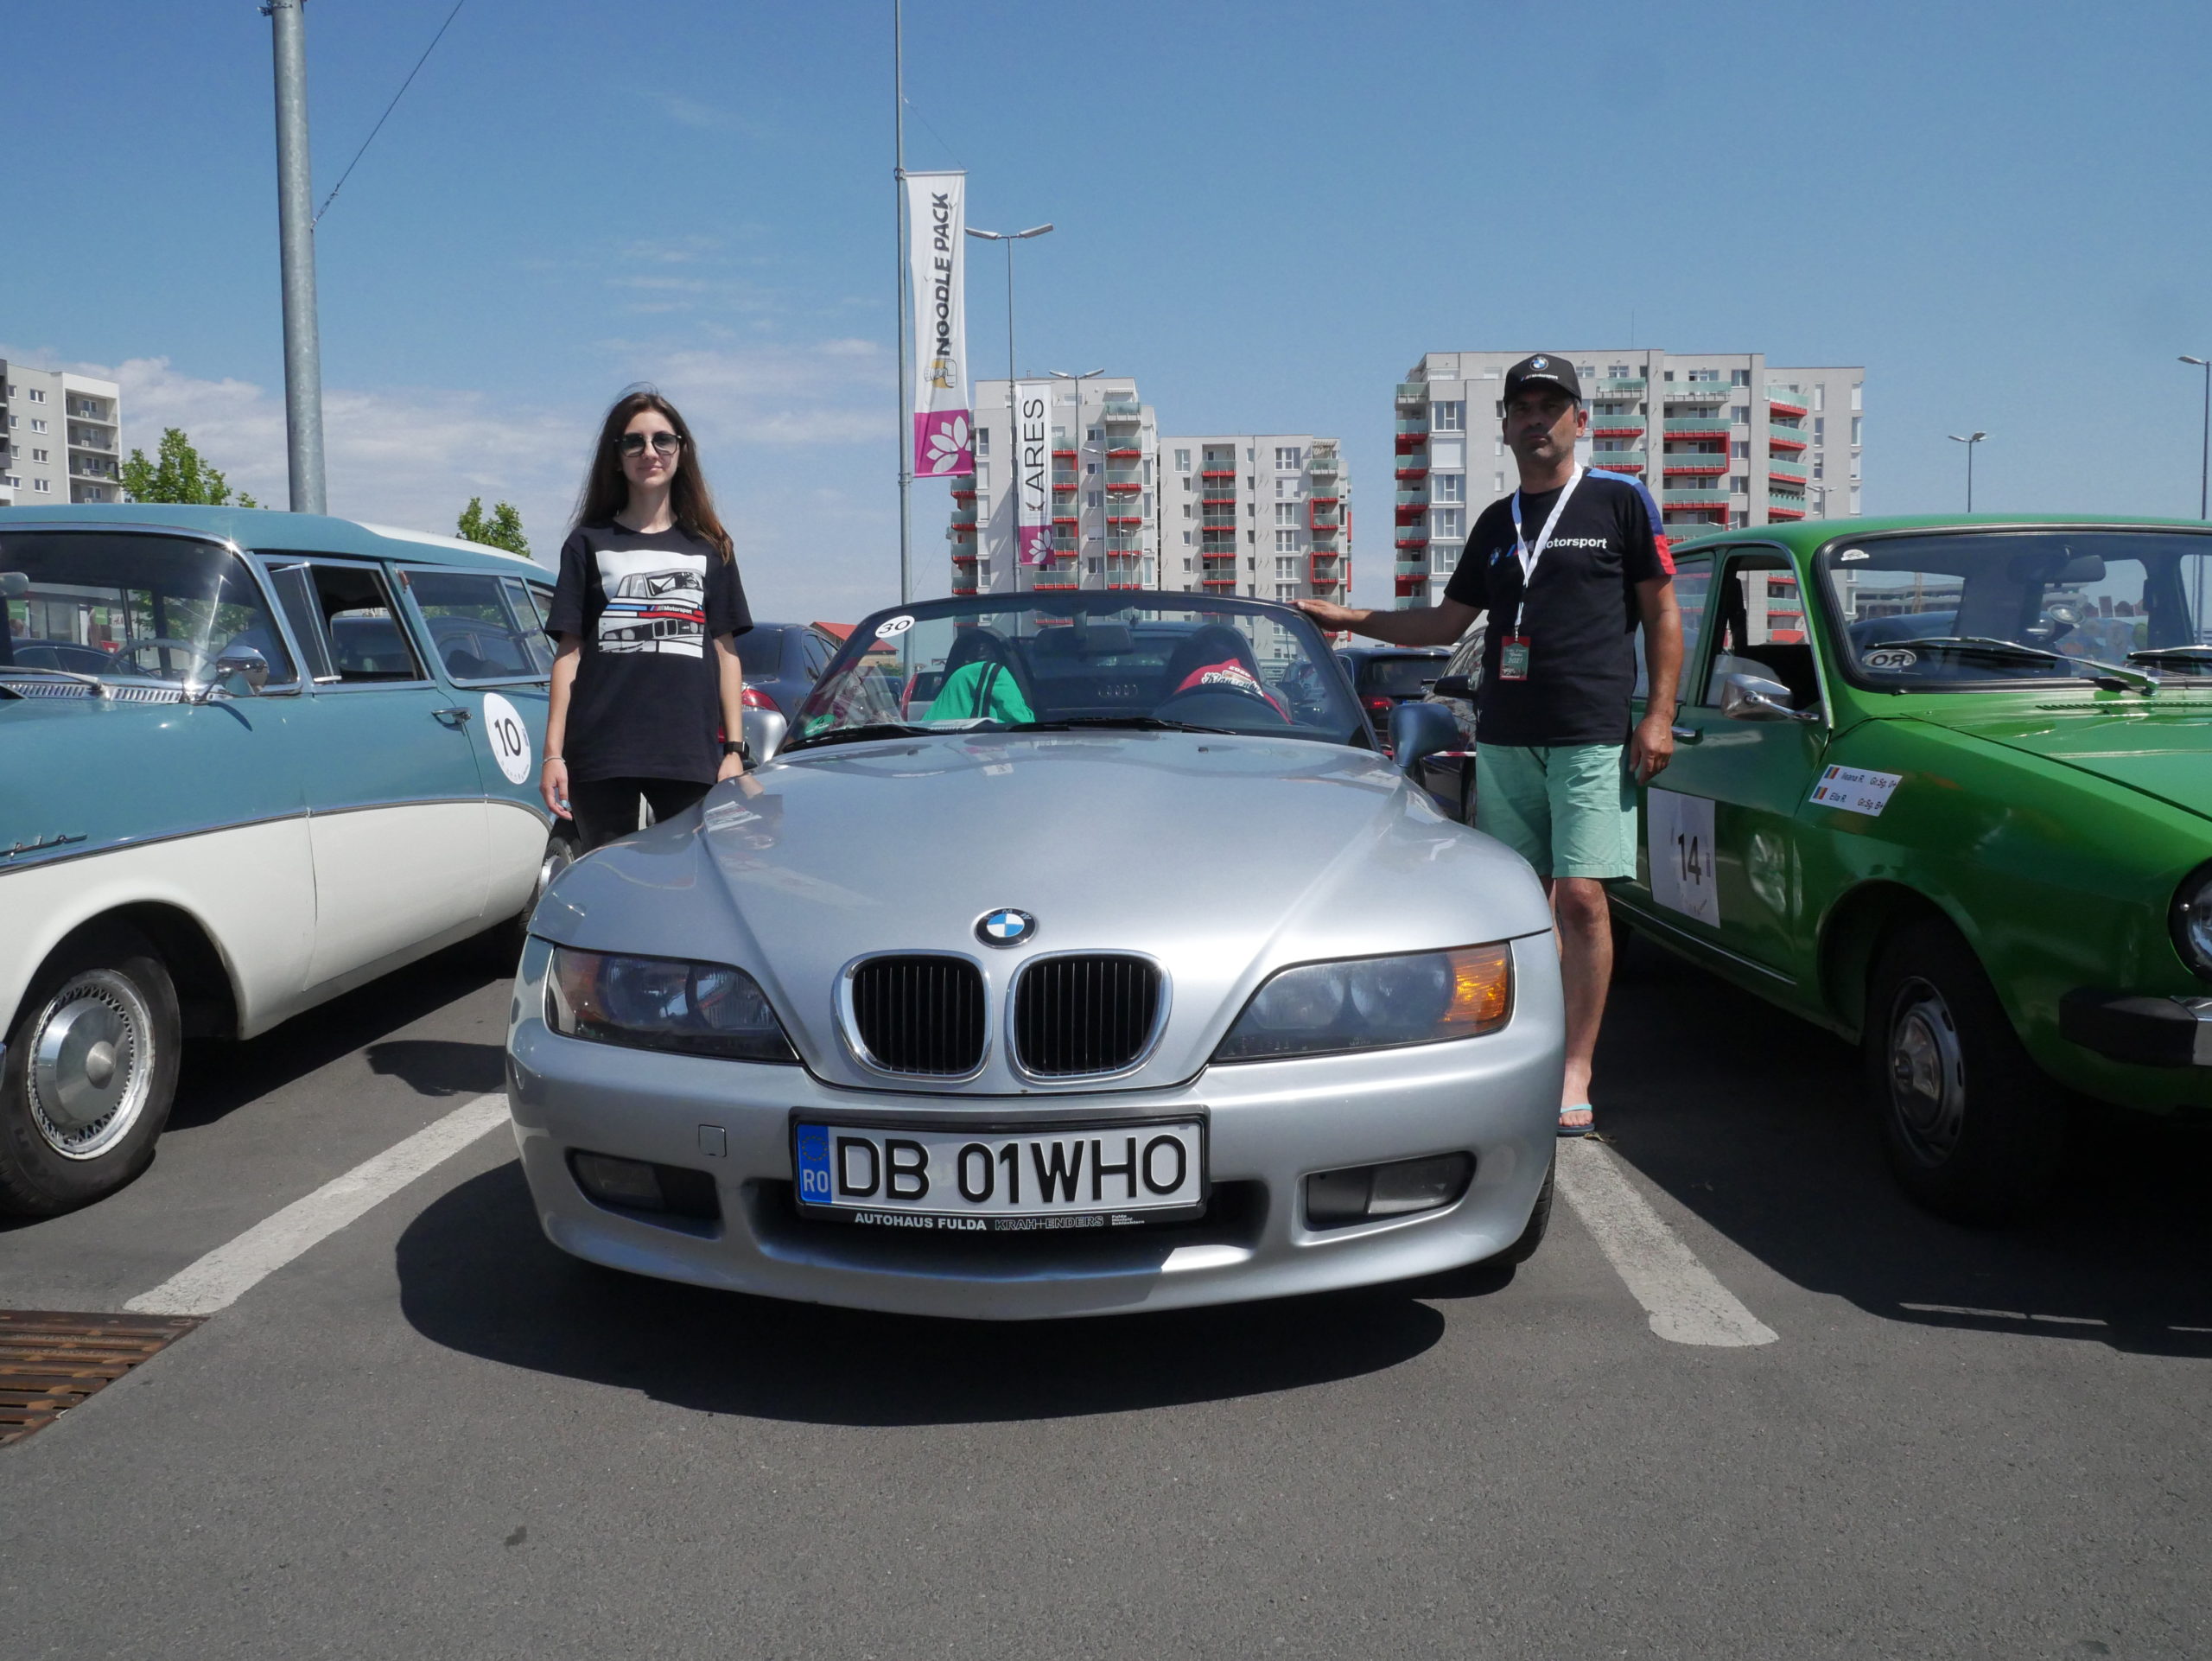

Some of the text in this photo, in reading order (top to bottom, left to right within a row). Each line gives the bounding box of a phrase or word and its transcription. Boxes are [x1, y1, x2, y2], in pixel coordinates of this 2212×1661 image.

[931, 192, 951, 356] NOODLE PACK
[1023, 398, 1045, 493] ARES
[878, 619, 911, 634] 30
[493, 717, 522, 757] 10
[1678, 833, 1702, 885] 14
[803, 1169, 829, 1193] RO
[836, 1134, 1187, 1204] DB 01WHO
[855, 1212, 1104, 1231] AUTOHAUS FULDA KRAH+ENDERS
